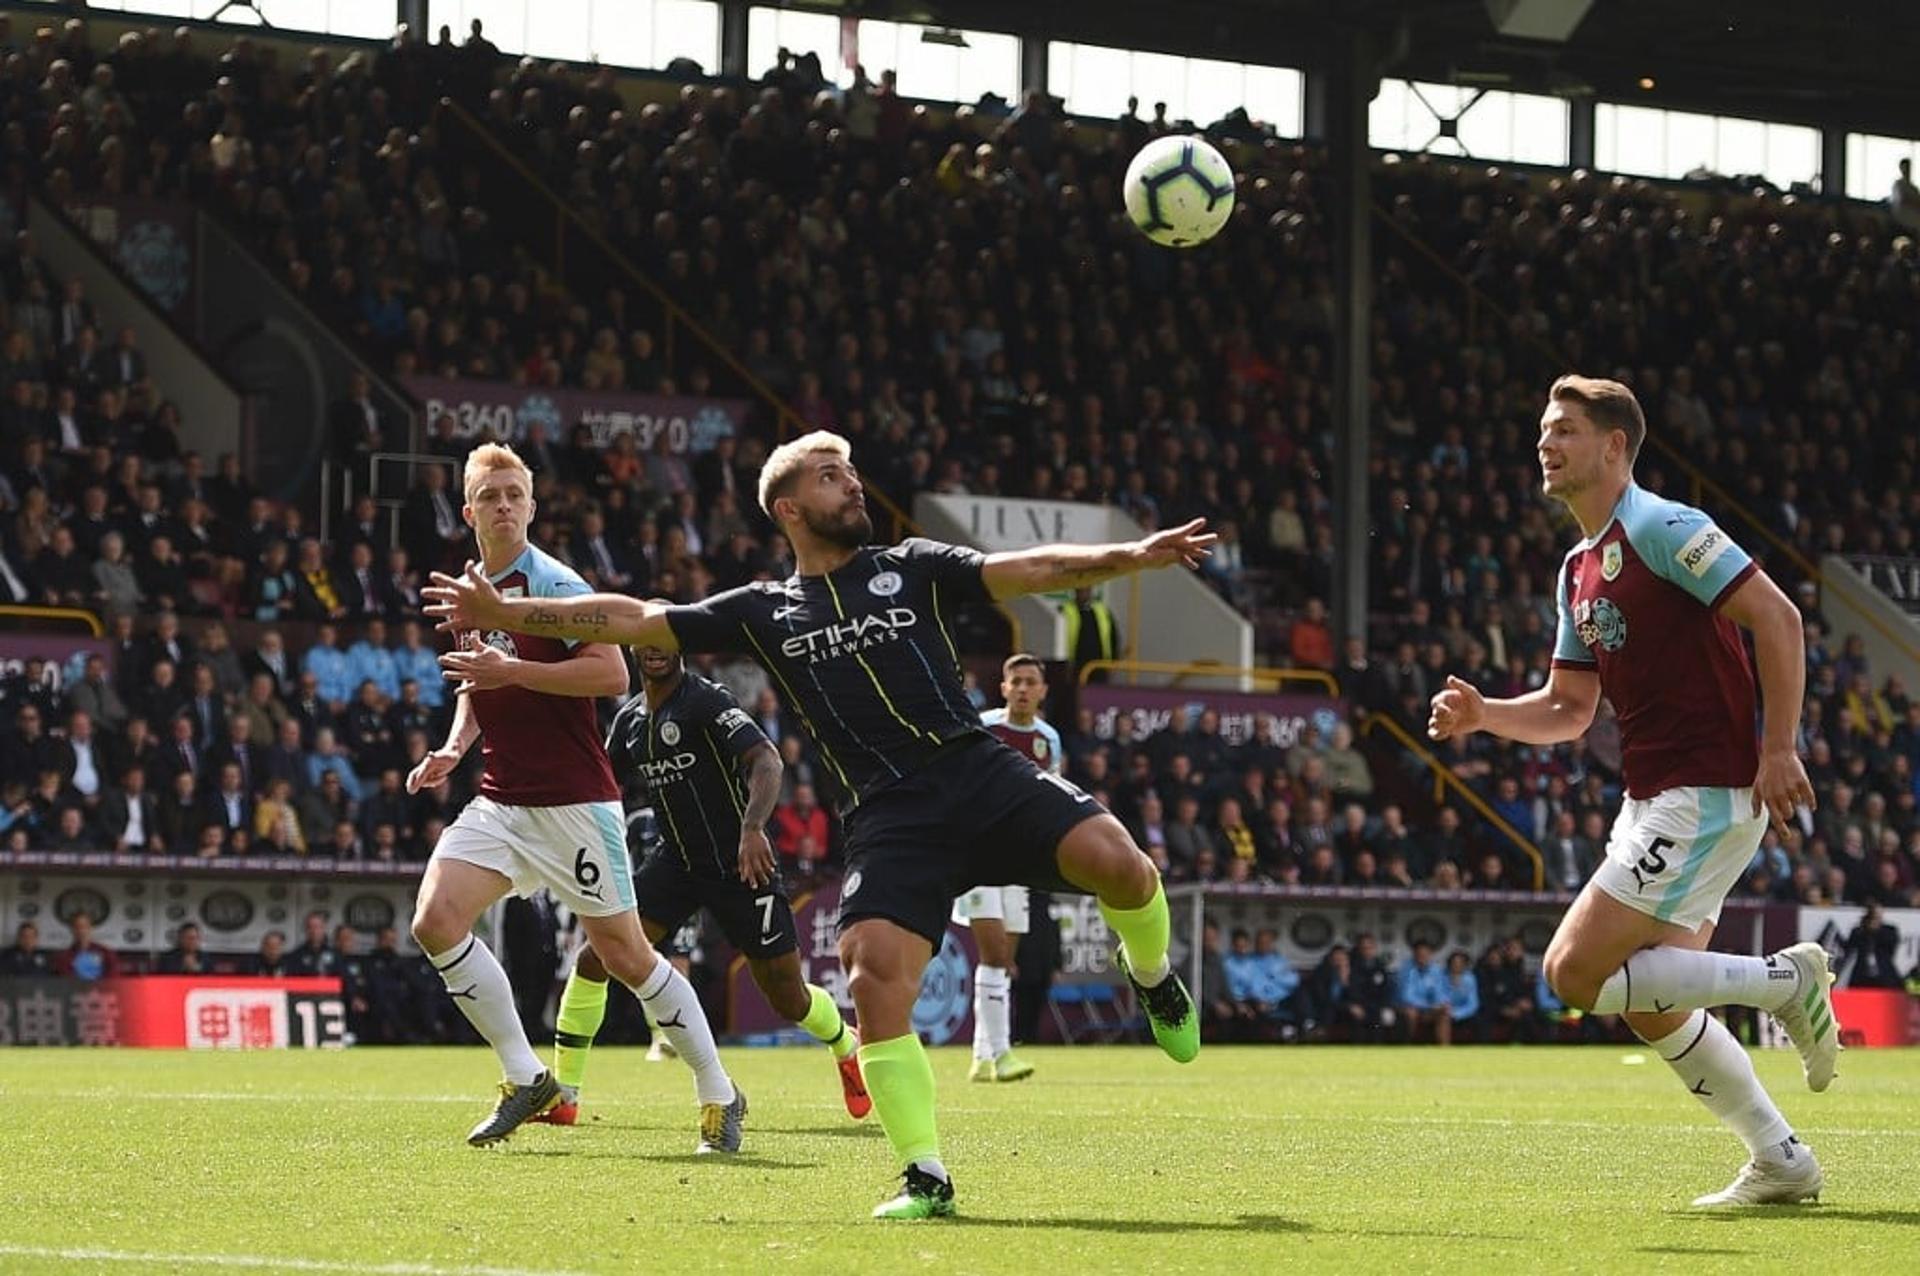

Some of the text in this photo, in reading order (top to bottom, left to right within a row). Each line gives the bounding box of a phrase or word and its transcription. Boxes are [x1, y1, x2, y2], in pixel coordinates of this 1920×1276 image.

[781, 608, 917, 658] ETIHAD
[809, 629, 899, 664] AIRWAYS
[575, 846, 601, 887] 6
[1638, 836, 1675, 875] 5
[754, 895, 776, 933] 7
